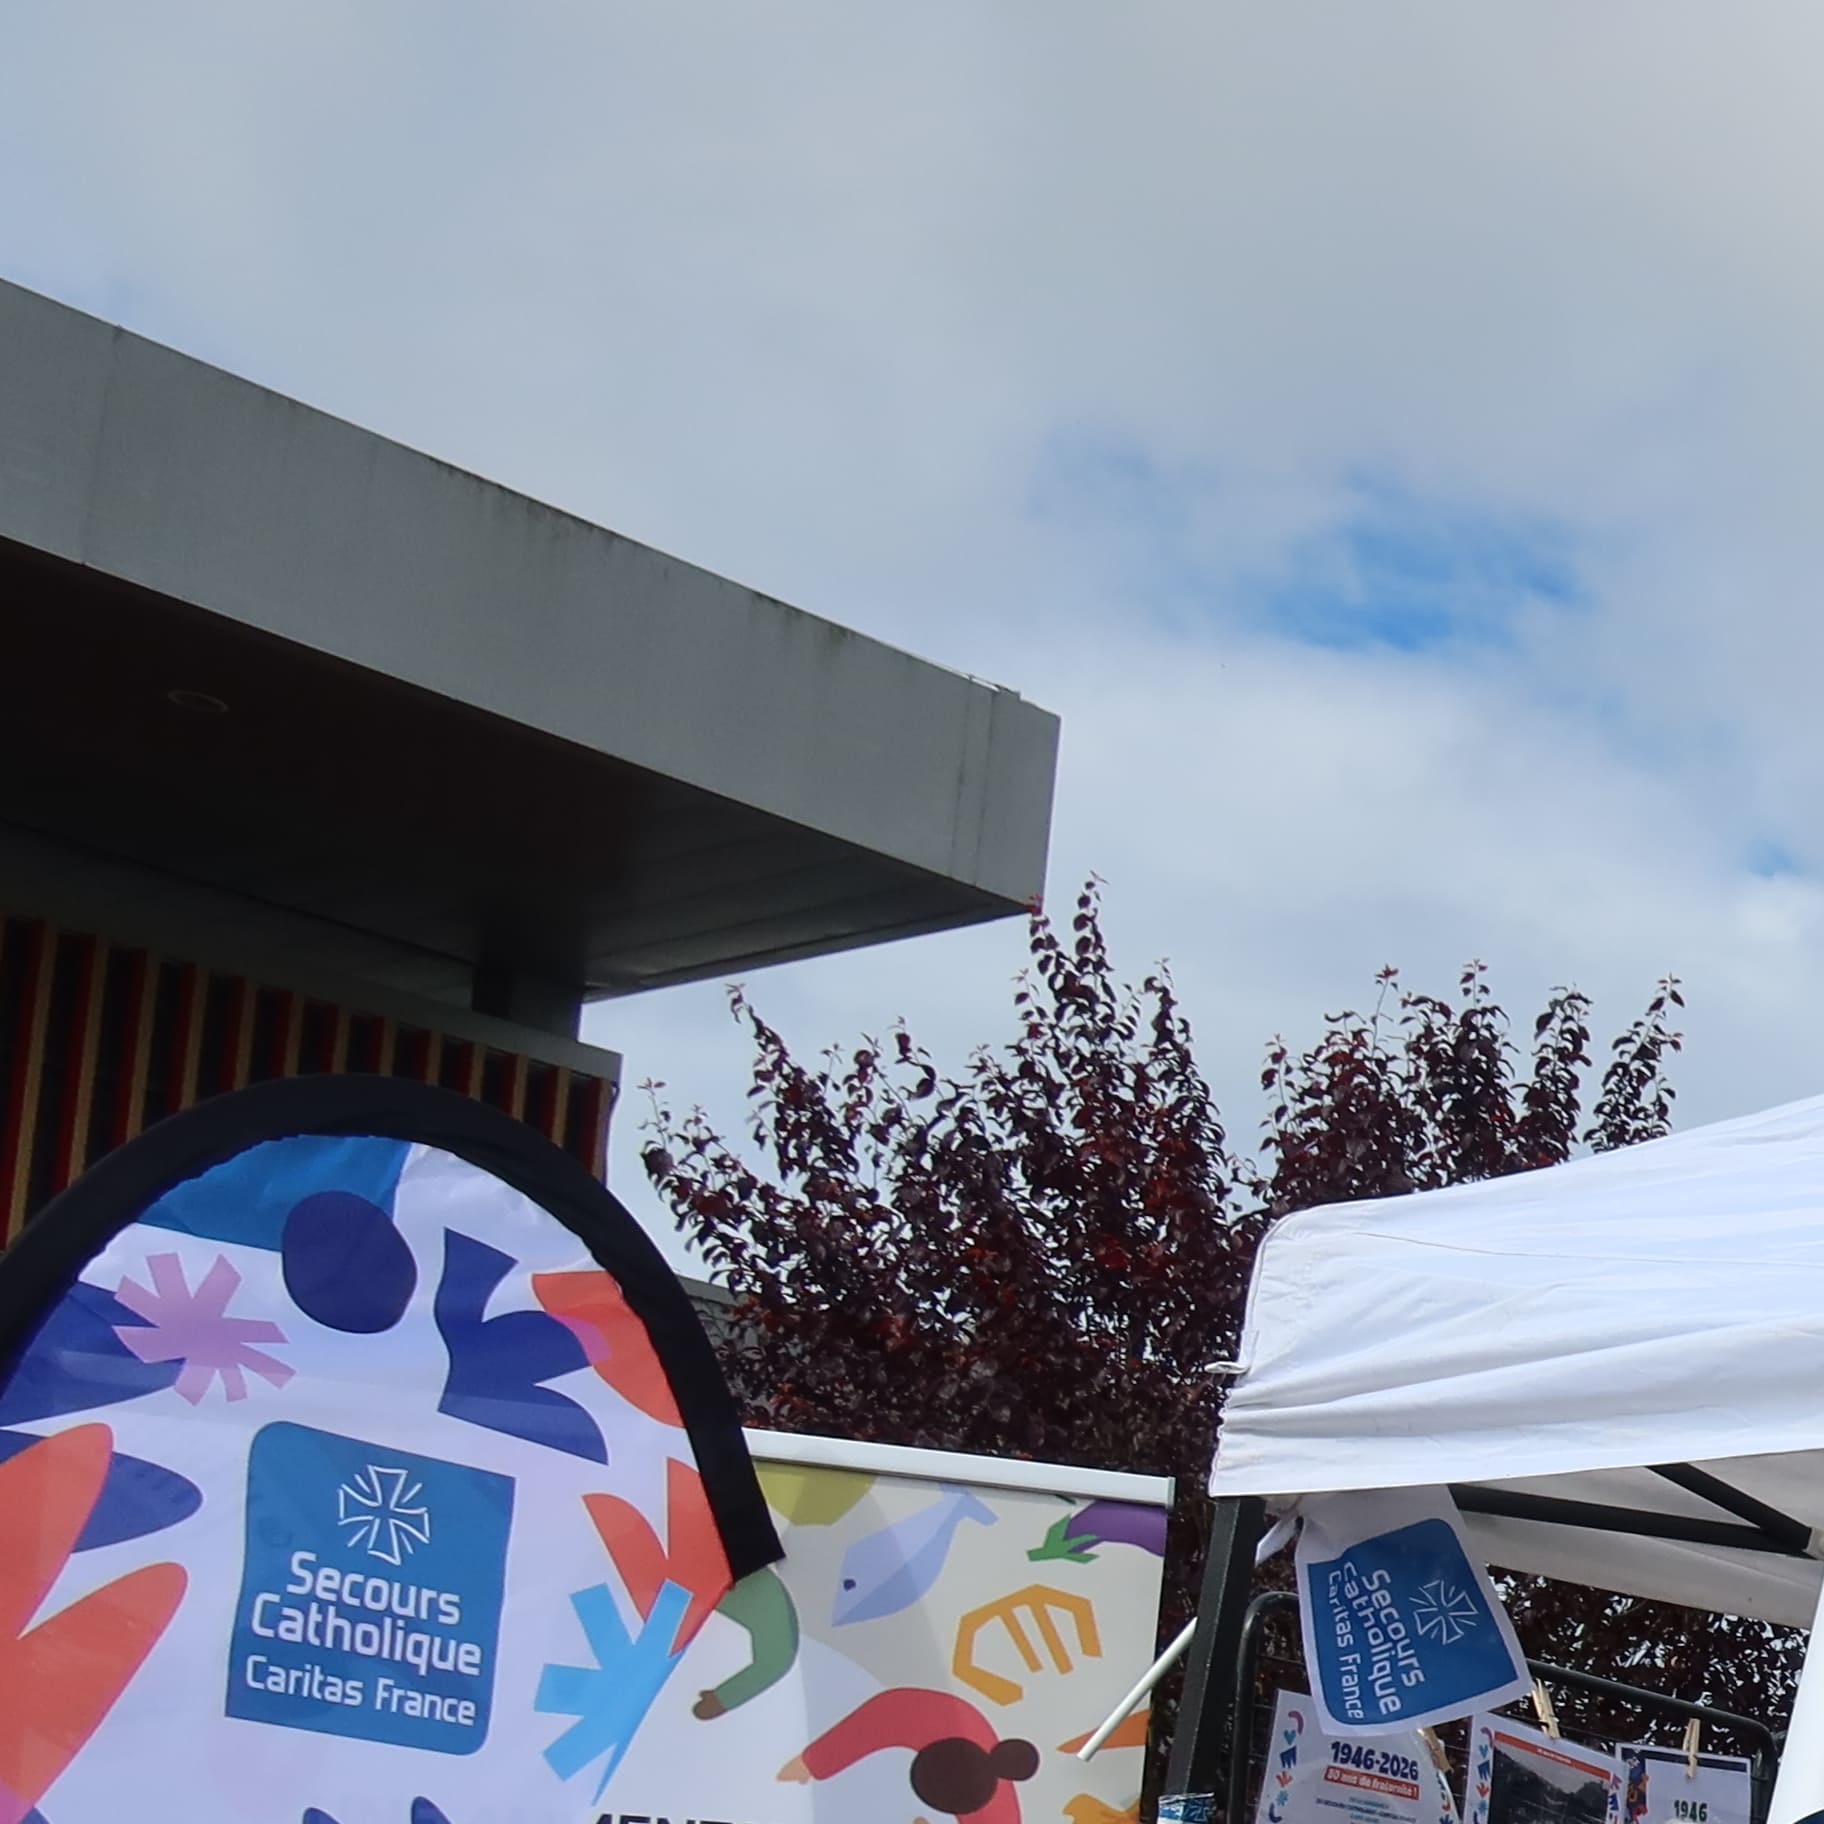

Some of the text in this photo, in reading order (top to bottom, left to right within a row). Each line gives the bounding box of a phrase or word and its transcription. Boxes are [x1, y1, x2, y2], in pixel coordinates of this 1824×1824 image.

[286, 1550, 461, 1626] Secours
[1362, 1569, 1426, 1688] Secours
[250, 1591, 482, 1677] Catholique
[1328, 1570, 1364, 1719] Caritas France
[1343, 1561, 1402, 1715] Catholique
[245, 1655, 477, 1727] Caritas France
[1330, 1740, 1419, 1781] 1946-2026
[1673, 1799, 1708, 1822] 1946
